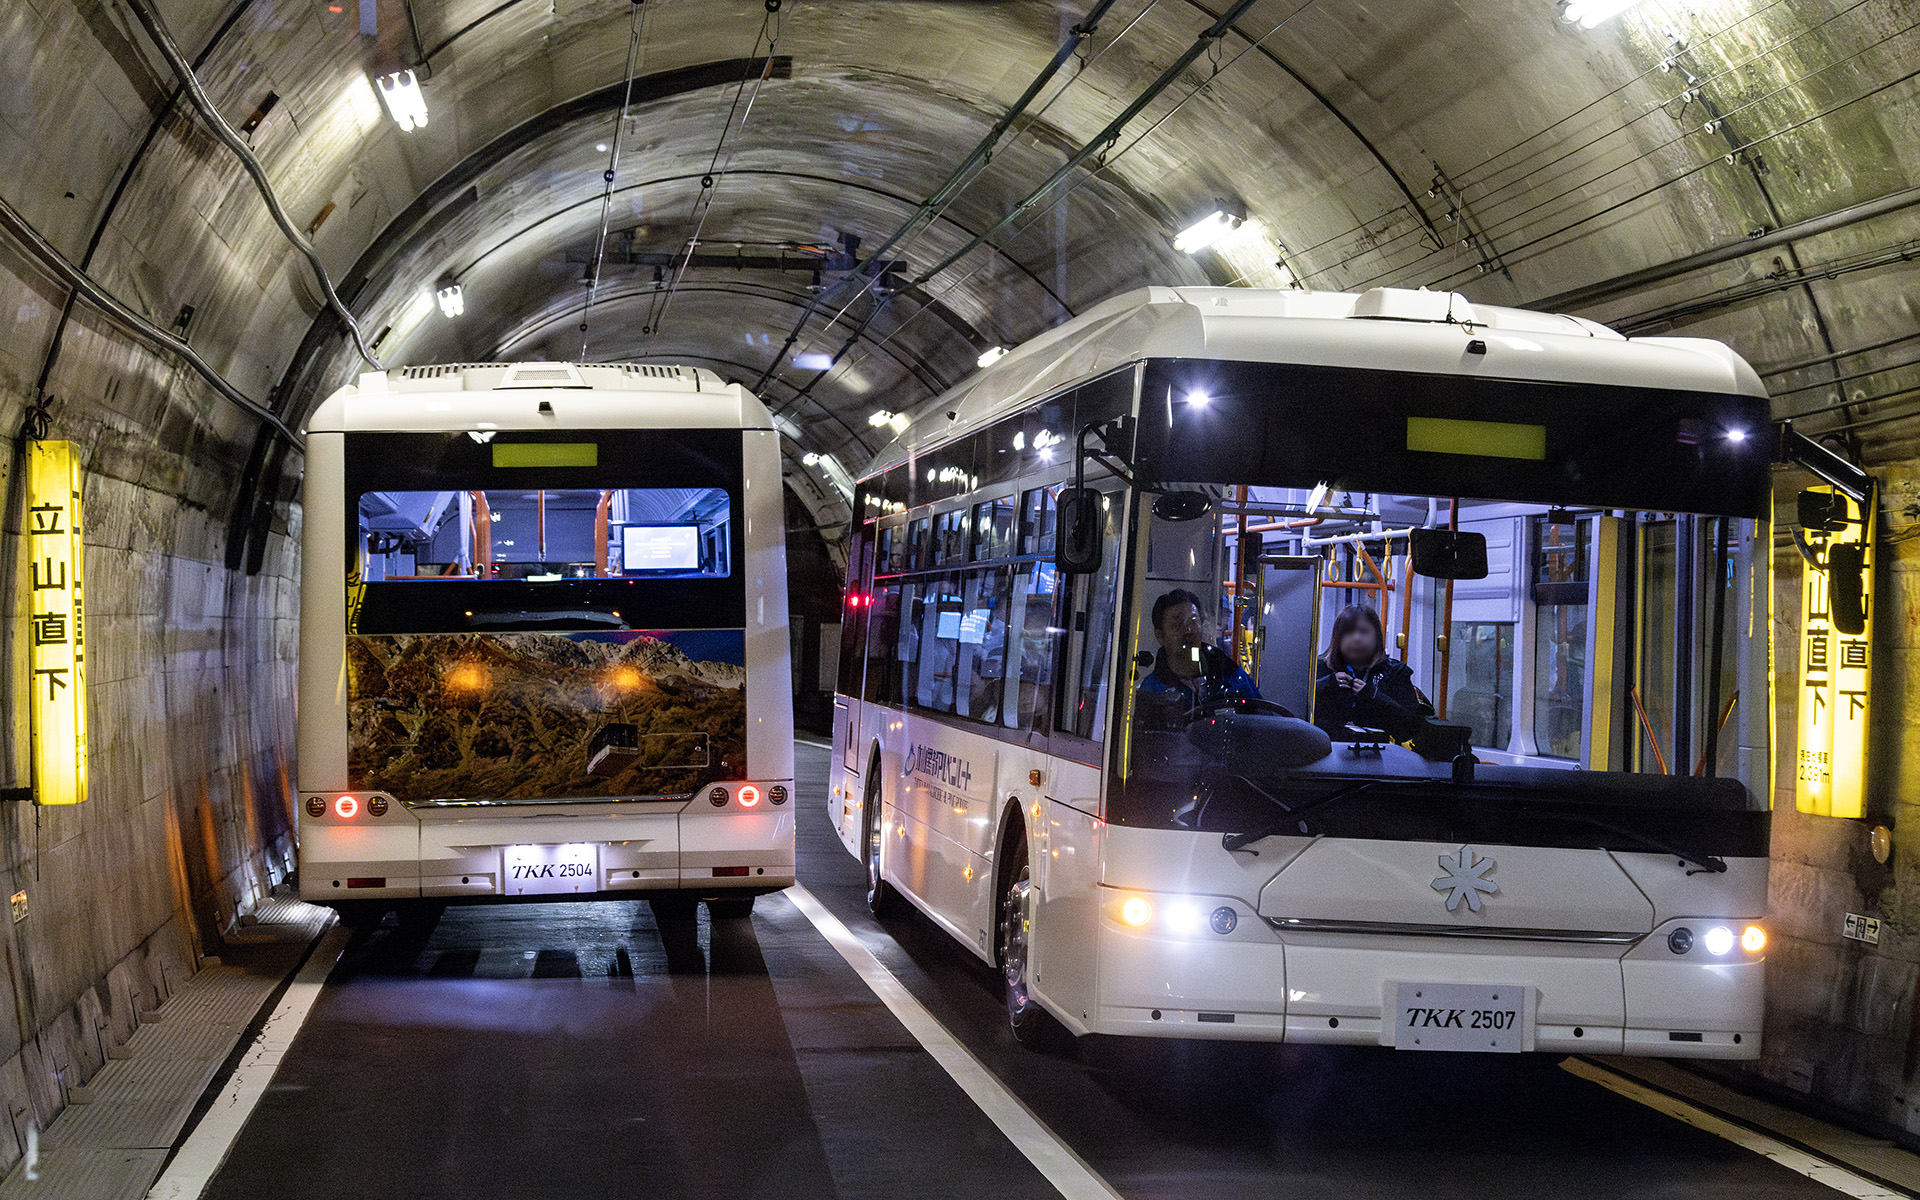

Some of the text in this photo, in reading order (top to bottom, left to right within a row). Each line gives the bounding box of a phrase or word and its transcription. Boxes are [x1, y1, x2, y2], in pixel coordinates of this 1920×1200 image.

[30, 502, 68, 701] 立山直下
[512, 863, 592, 879] TKK 2504
[1406, 1008, 1516, 1029] TKK 2507
